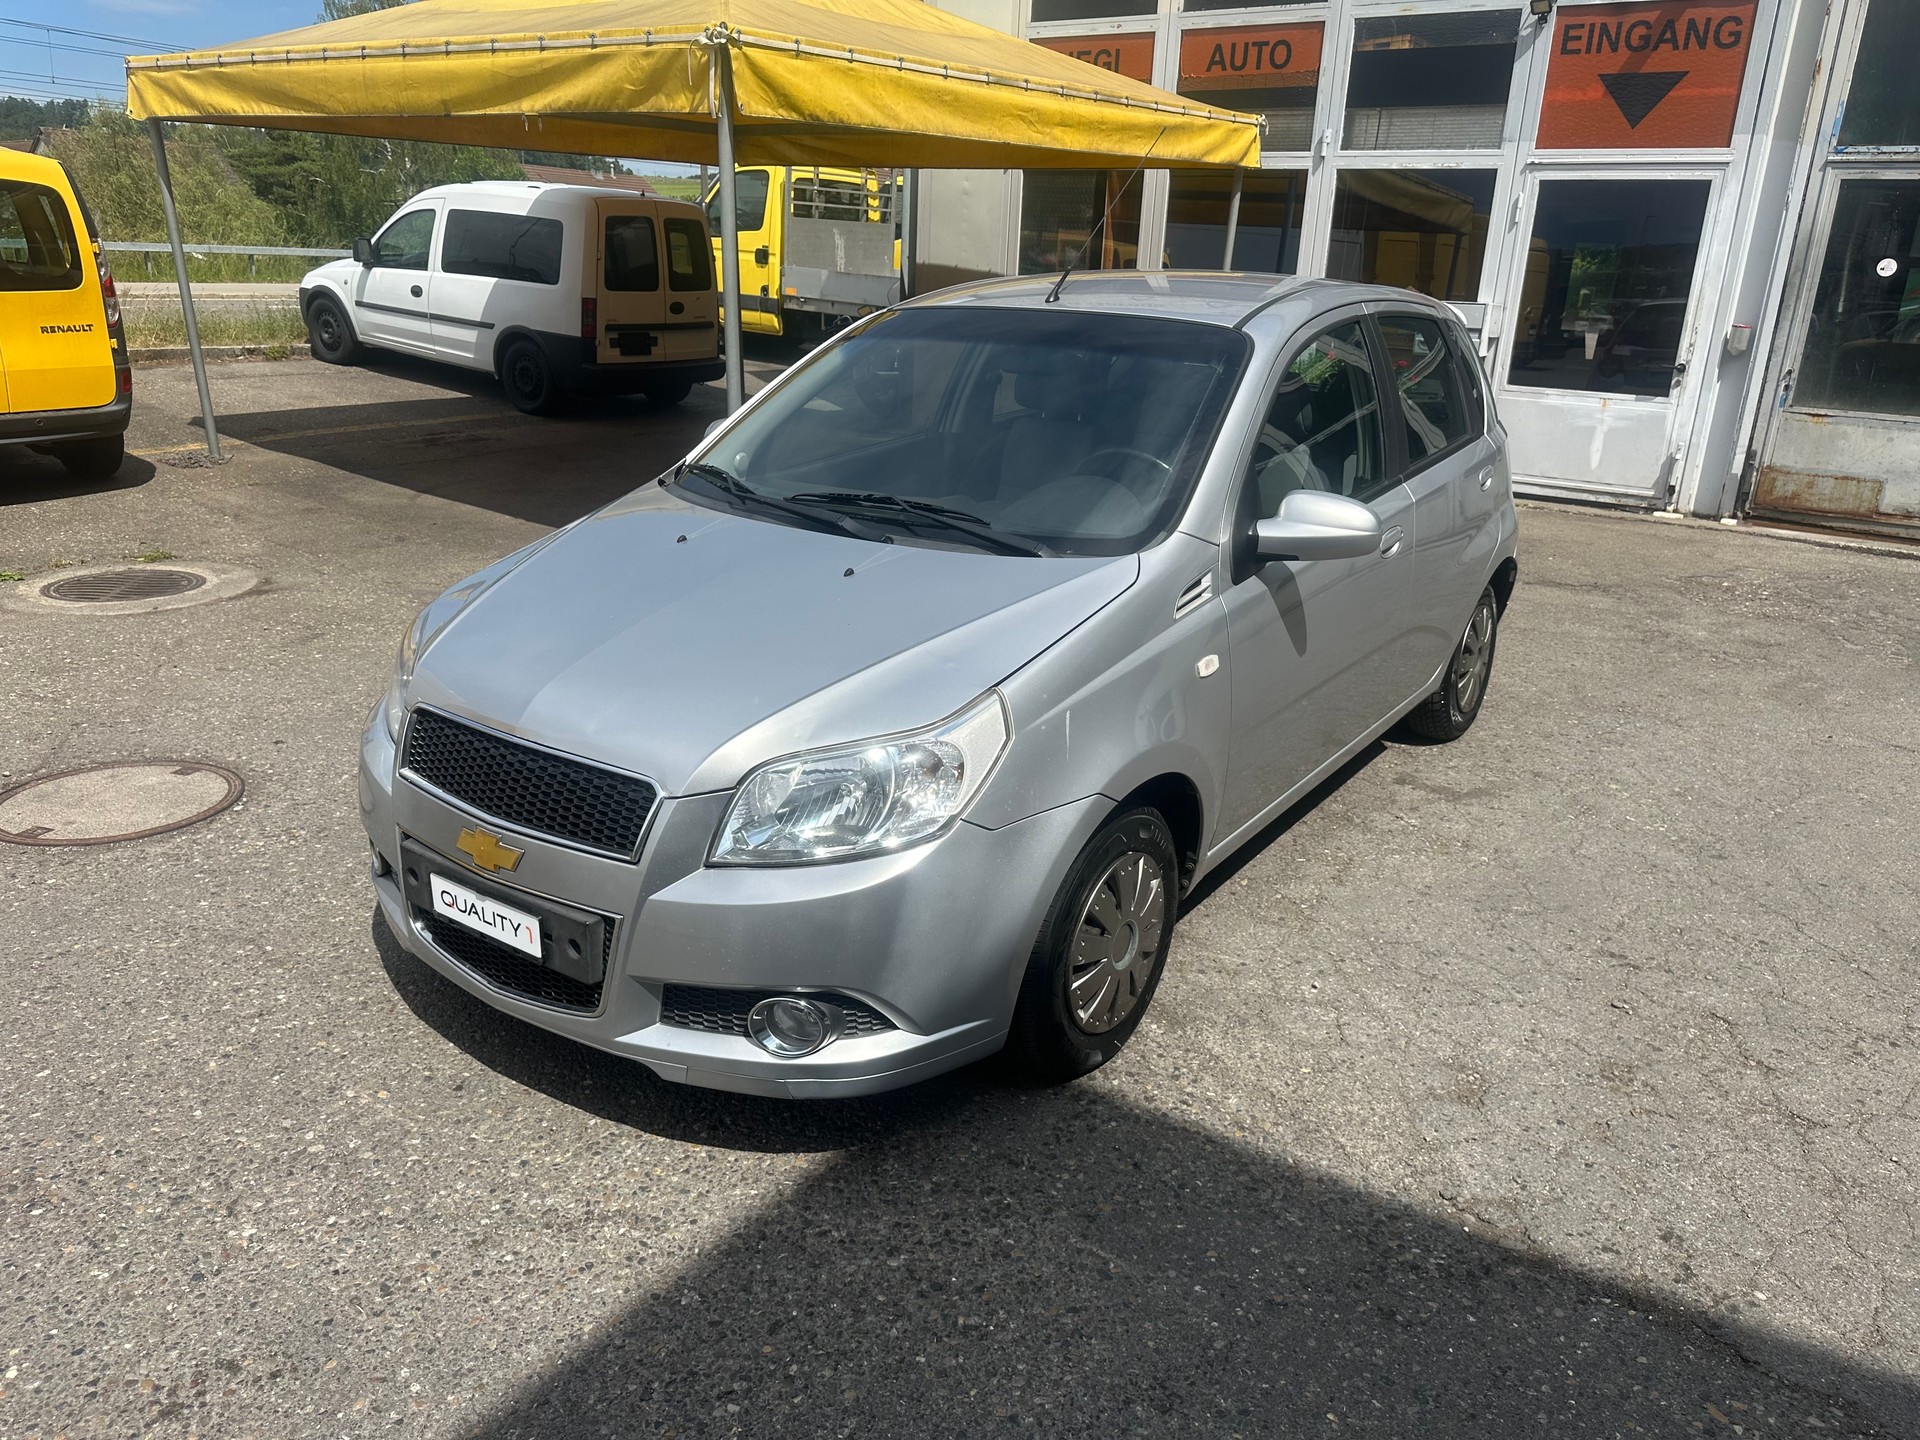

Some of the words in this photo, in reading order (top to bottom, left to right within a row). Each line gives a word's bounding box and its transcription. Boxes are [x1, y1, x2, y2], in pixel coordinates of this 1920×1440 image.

[1560, 15, 1744, 56] EINGANG
[1205, 39, 1292, 72] AUTO
[40, 323, 94, 334] RENAULT
